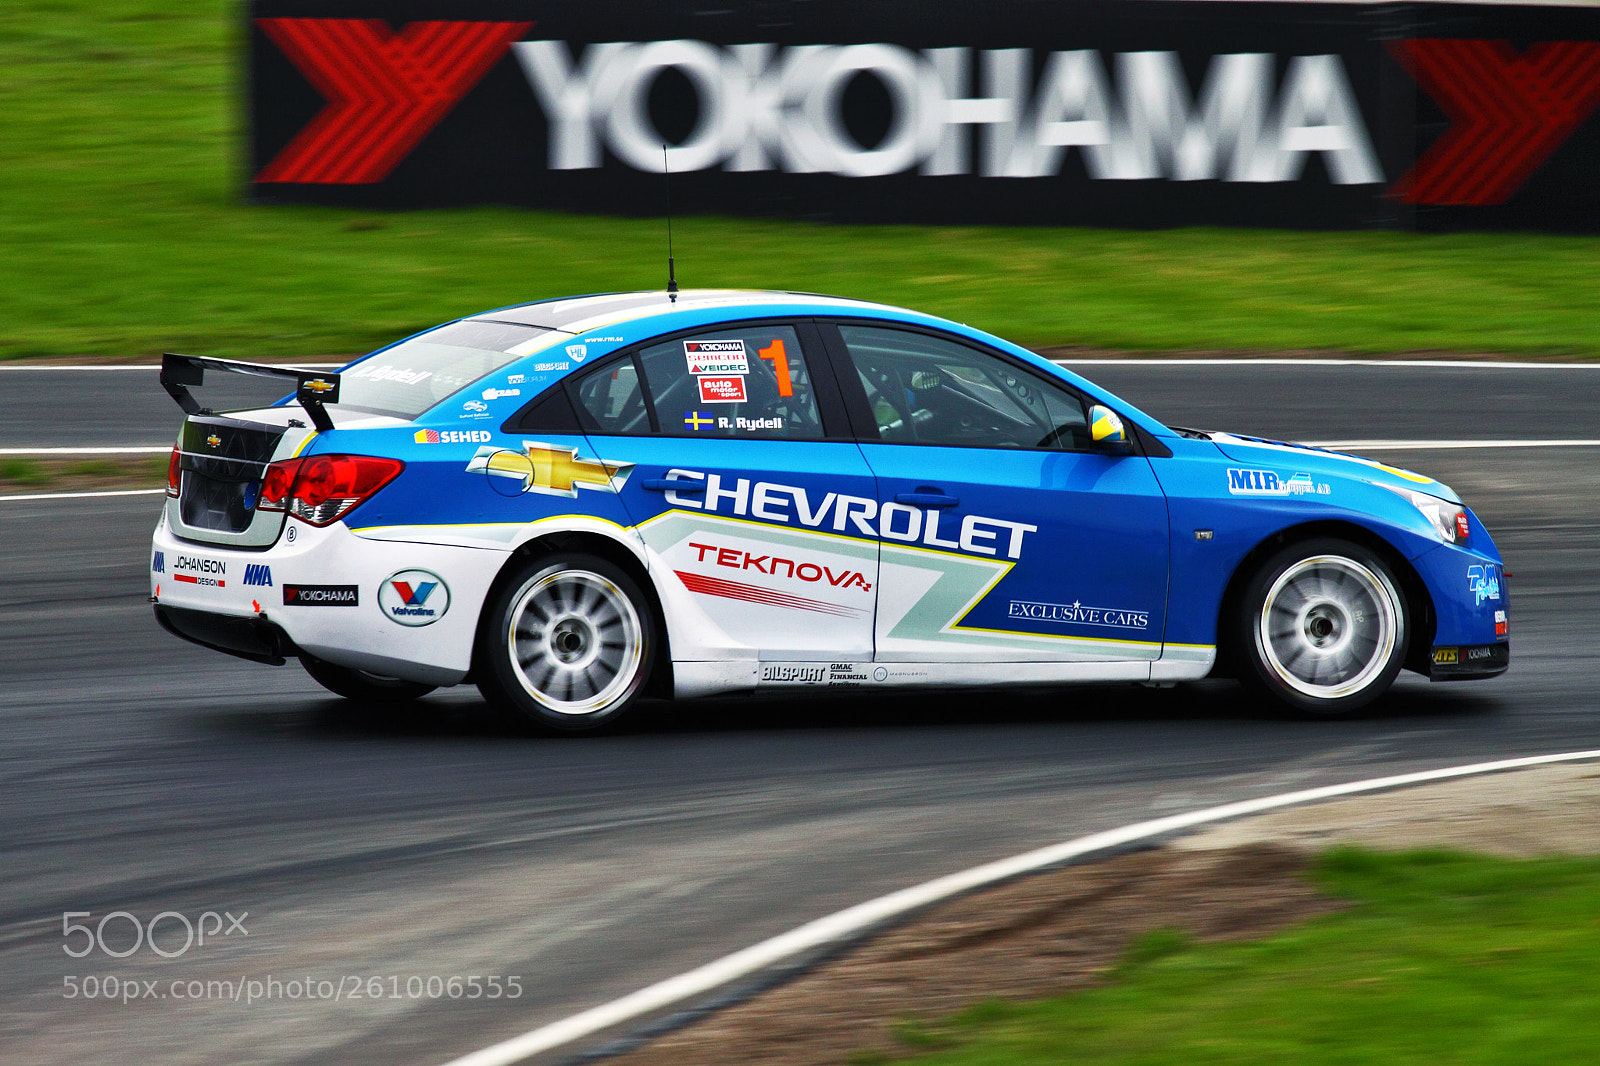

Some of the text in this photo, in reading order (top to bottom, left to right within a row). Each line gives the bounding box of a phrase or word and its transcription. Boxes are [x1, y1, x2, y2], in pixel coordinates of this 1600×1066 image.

[513, 39, 1385, 186] YOKOHAMA
[700, 343, 742, 351] YOKOHAMA
[701, 364, 747, 372] VEIDEC
[759, 340, 793, 397] 1
[703, 380, 732, 388] auto
[718, 417, 782, 431] R. Rydell
[440, 430, 492, 443] SEHED
[1229, 470, 1279, 490] MIR
[664, 468, 1038, 561] CHEVROLET
[174, 556, 226, 574] JOHANSON
[688, 541, 872, 592] TEKNOVA
[197, 577, 219, 587] DESIGN
[298, 590, 356, 601] YOKOHAMA
[391, 606, 437, 616] Valvoline
[1008, 602, 1149, 627] EXCLUSIVE CARS
[1435, 649, 1457, 662] ATS
[762, 666, 826, 682] BILSPORT
